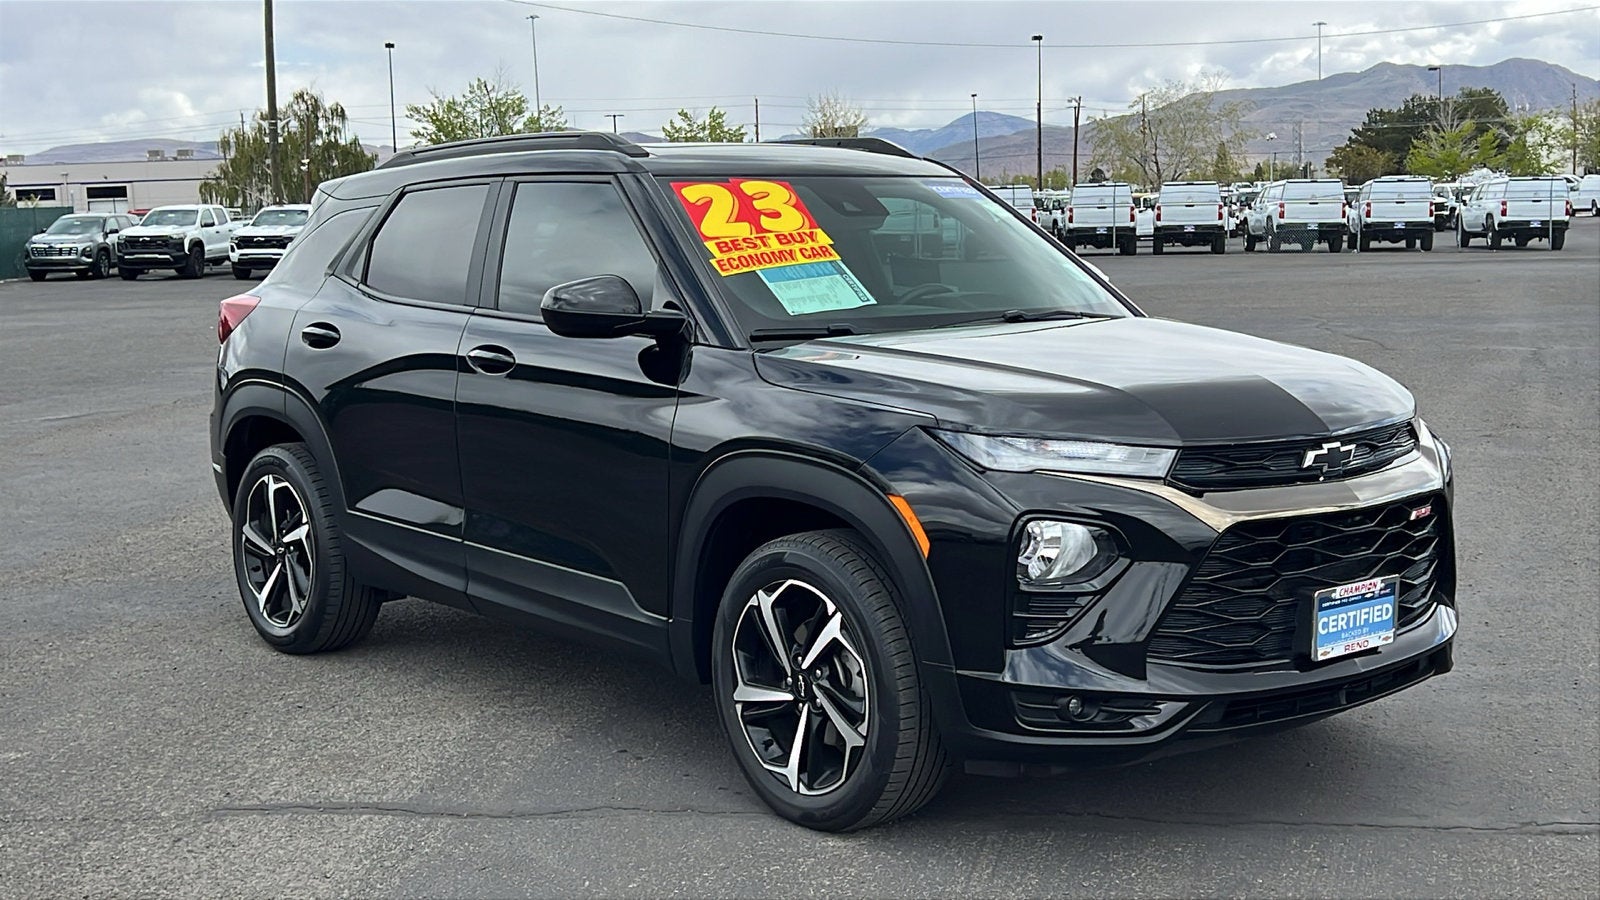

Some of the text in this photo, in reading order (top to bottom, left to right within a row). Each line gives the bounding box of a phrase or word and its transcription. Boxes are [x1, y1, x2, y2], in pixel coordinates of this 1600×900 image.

[681, 181, 811, 238] 23
[715, 230, 819, 254] BEST BUY
[716, 245, 834, 273] ECONOMY CAR
[1339, 580, 1378, 597] CHAMPION
[1318, 603, 1393, 635] CERTIFIED
[1344, 640, 1369, 652] RENO
